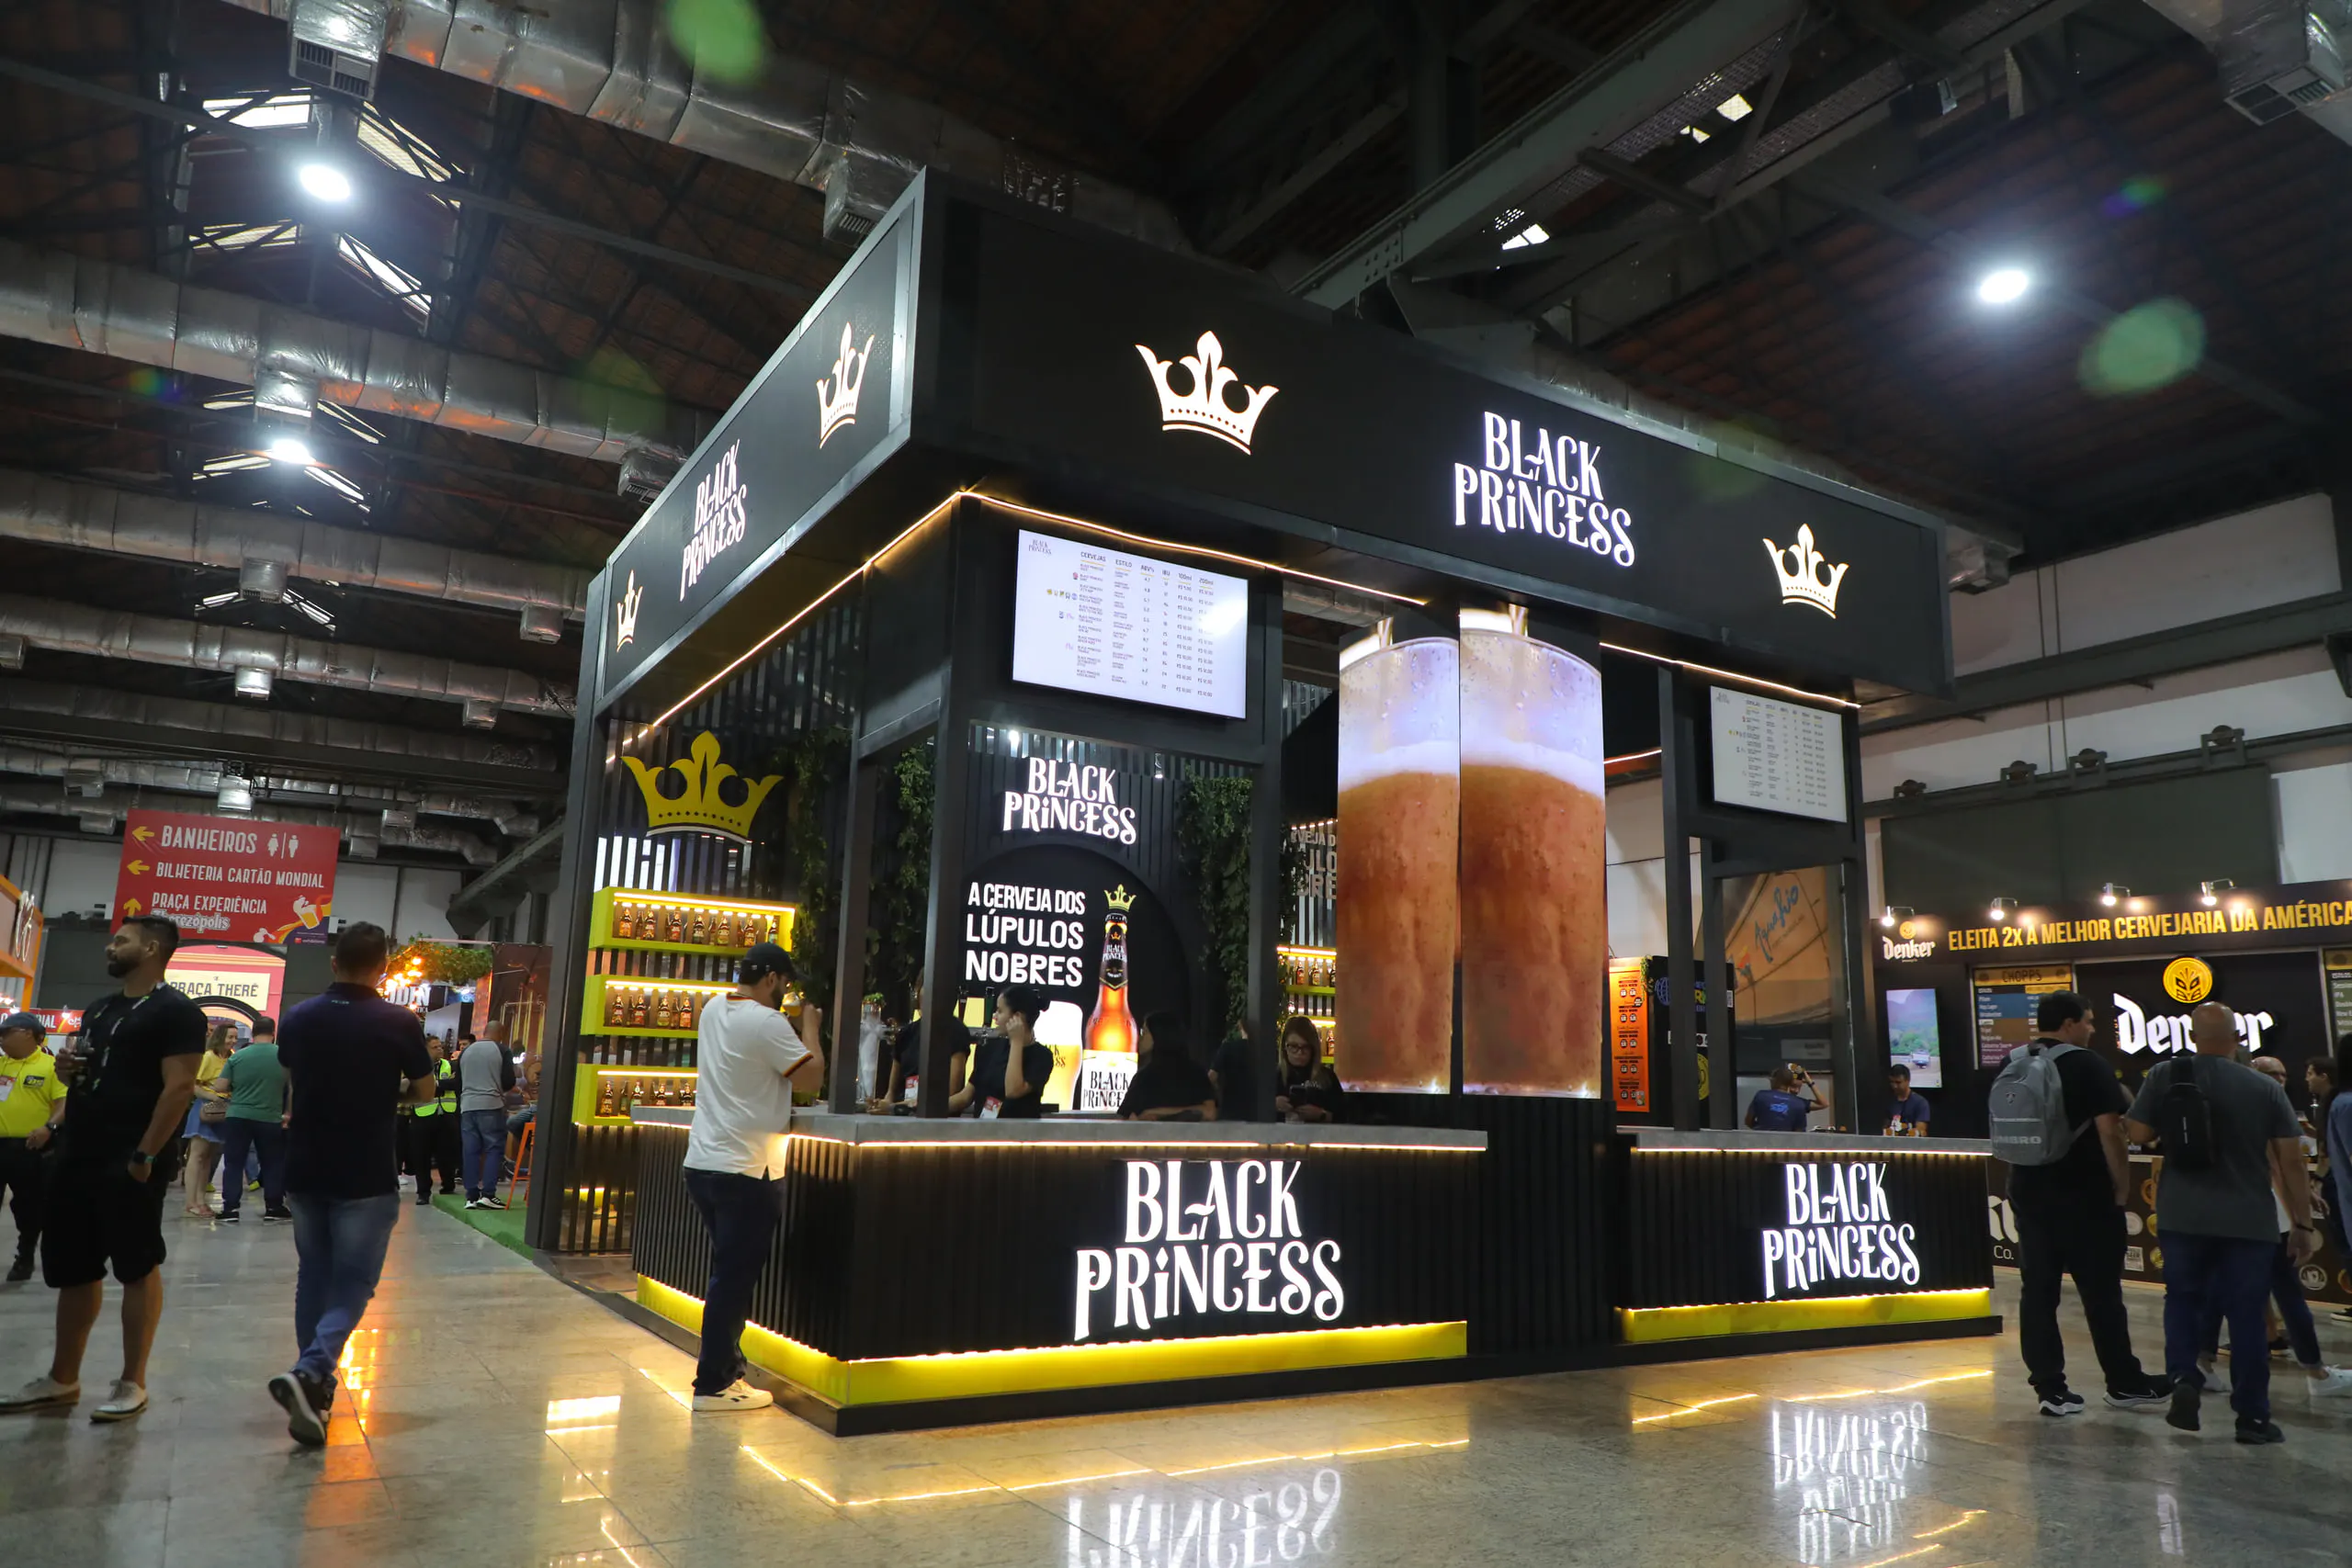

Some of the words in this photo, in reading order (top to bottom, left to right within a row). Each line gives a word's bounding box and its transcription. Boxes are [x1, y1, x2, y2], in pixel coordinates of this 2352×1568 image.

[1484, 411, 1604, 501] BLACK
[694, 438, 741, 535] BLACK
[1115, 558, 1133, 568] ESTILO
[1027, 756, 1116, 806] BLACK
[161, 825, 258, 854] BANHEIROS
[156, 862, 223, 882] BILHETERIA
[227, 867, 272, 886] CARTÃO
[276, 871, 324, 888] MONDIAL
[152, 892, 189, 910] PRAÇA
[194, 895, 267, 915] EXPERIÊNCIA
[967, 882, 981, 907] A
[983, 883, 1052, 912] CERVEJA
[1055, 889, 1086, 916] DOS
[966, 909, 1084, 950] LÚPULOS
[1883, 935, 1936, 960] Denker
[1949, 928, 1999, 952] ELEITA
[2027, 923, 2039, 945] A
[2041, 919, 2112, 944] MELHOR
[2114, 910, 2227, 940] CERVEJARIA
[2231, 908, 2259, 932] DA
[965, 950, 1083, 987] NOBRES
[2002, 969, 2043, 983] CHOPPS
[2113, 993, 2274, 1055] Dener
[1125, 1159, 1303, 1243] BLACK
[1785, 1162, 1891, 1225] BLACK
[1994, 1246, 2015, 1260] Co.
